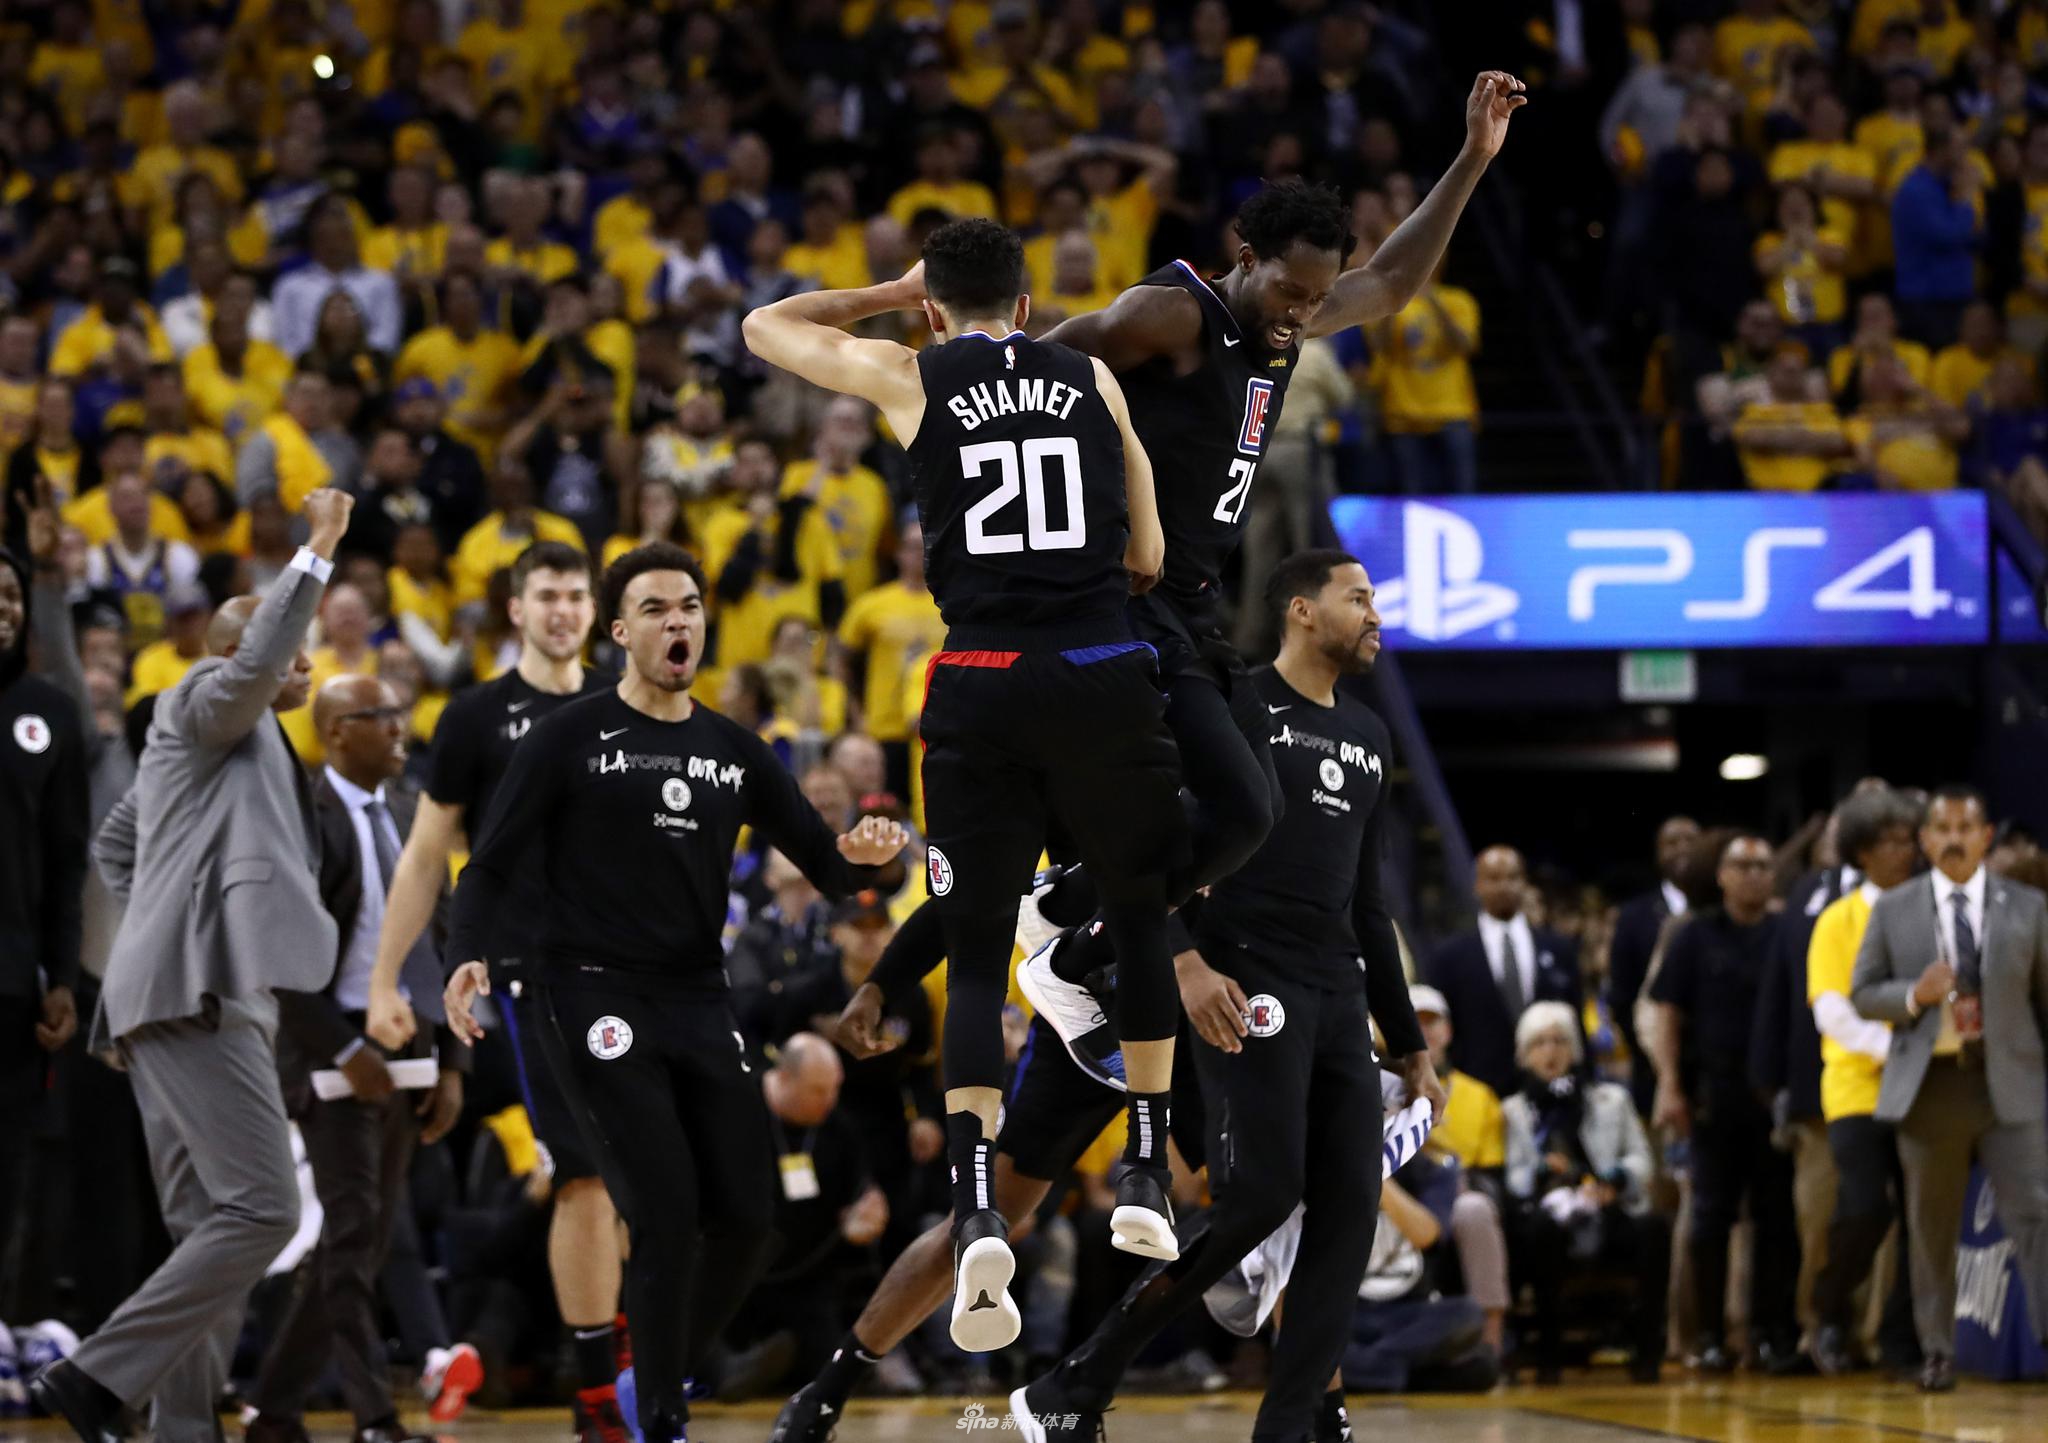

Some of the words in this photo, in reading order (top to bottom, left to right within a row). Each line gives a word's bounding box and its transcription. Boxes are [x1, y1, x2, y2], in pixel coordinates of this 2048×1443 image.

[946, 378, 1084, 431] SHAMET
[958, 436, 1087, 555] 20
[1566, 525, 1953, 624] PS4
[586, 748, 684, 774] PLAYOFFS
[687, 754, 720, 789] OUR
[1339, 741, 1370, 775] OUR
